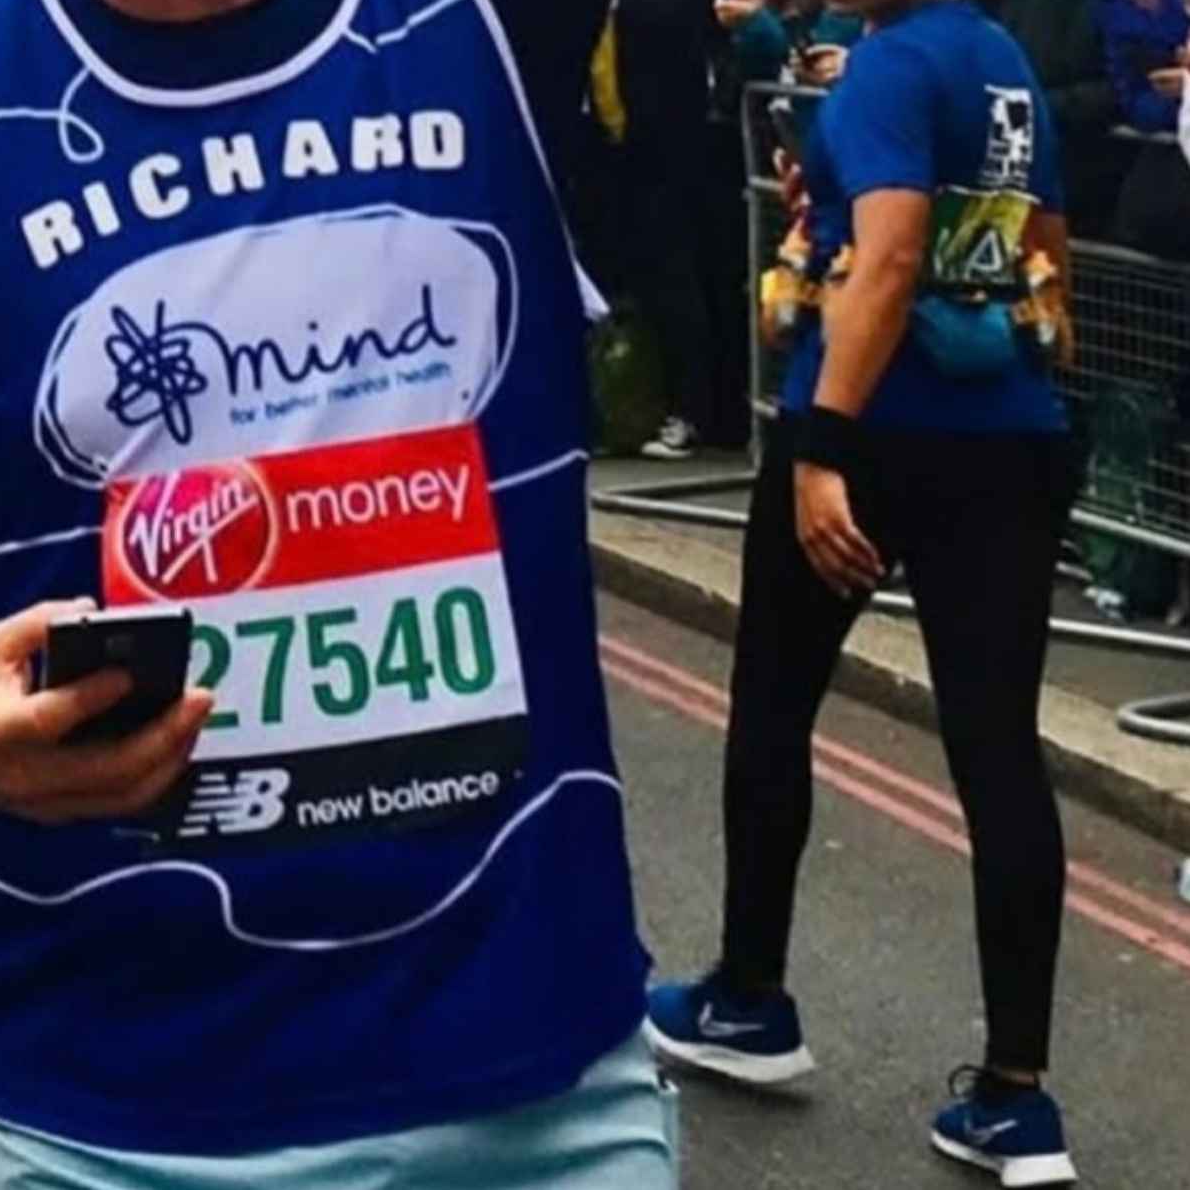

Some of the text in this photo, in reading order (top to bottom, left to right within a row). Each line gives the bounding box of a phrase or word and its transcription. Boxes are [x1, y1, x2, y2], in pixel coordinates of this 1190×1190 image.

[21, 109, 465, 269] RICHARD
[214, 285, 457, 397] mind
[128, 465, 470, 584] Virgin money
[296, 771, 500, 828] new balance
